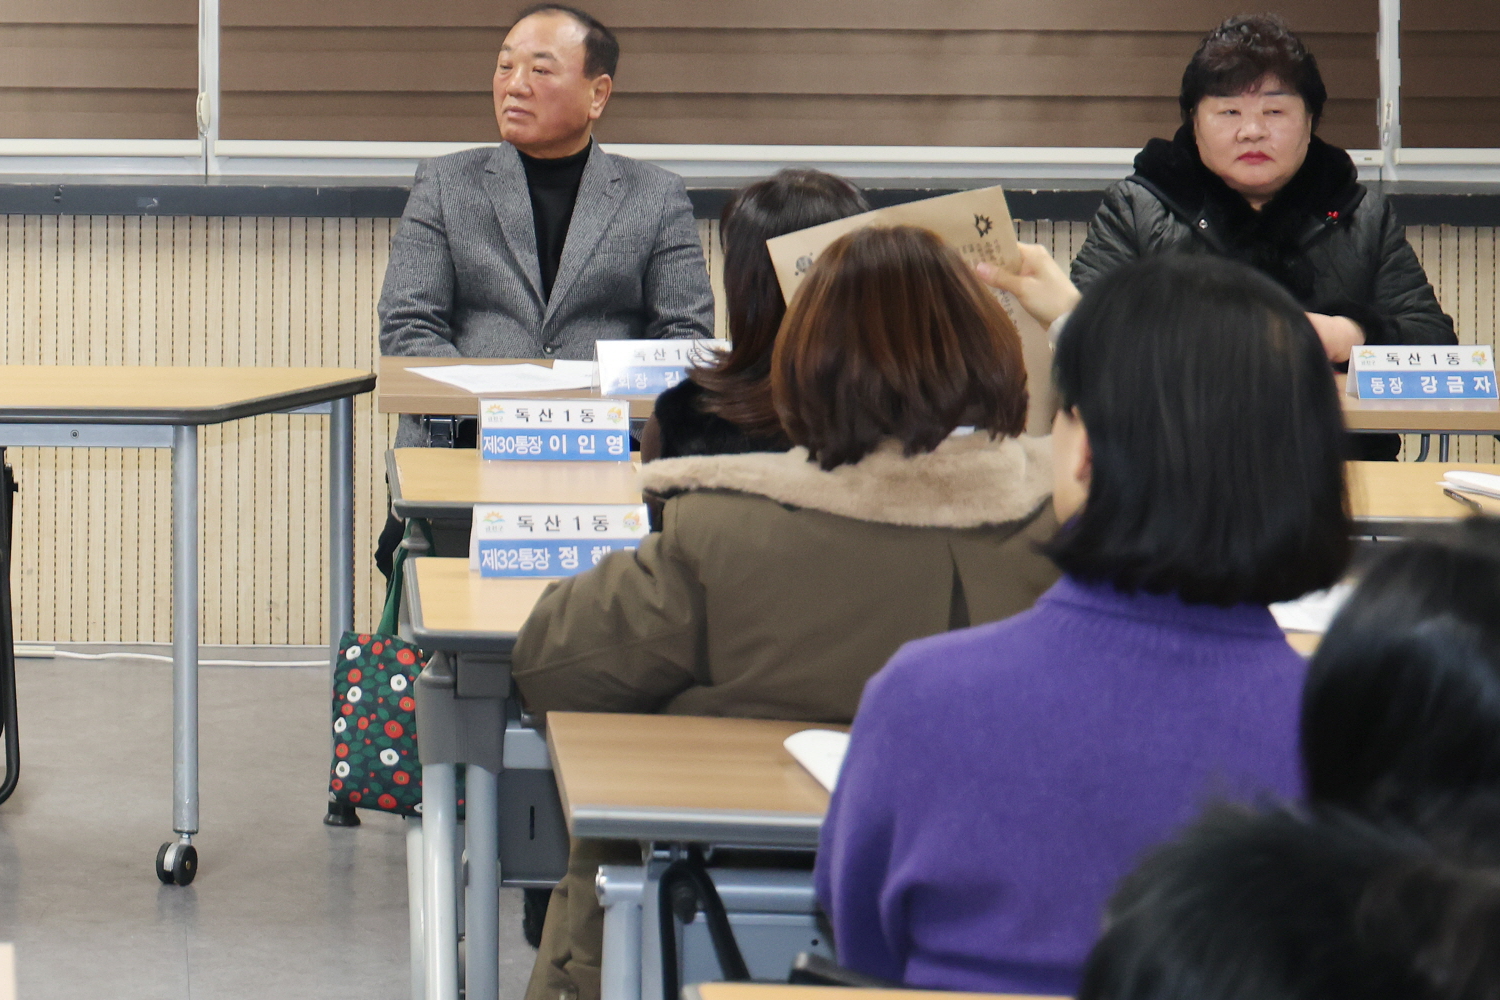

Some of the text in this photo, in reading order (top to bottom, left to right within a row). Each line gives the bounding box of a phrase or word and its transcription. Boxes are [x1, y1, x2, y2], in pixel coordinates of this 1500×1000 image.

[1386, 352, 1461, 366] 독산1동
[1420, 375, 1492, 394] 강금자
[515, 407, 596, 423] 독산1동
[483, 434, 624, 455] 제30통장 이인영
[517, 515, 610, 532] 독산1동
[481, 549, 551, 571] 제32통장
